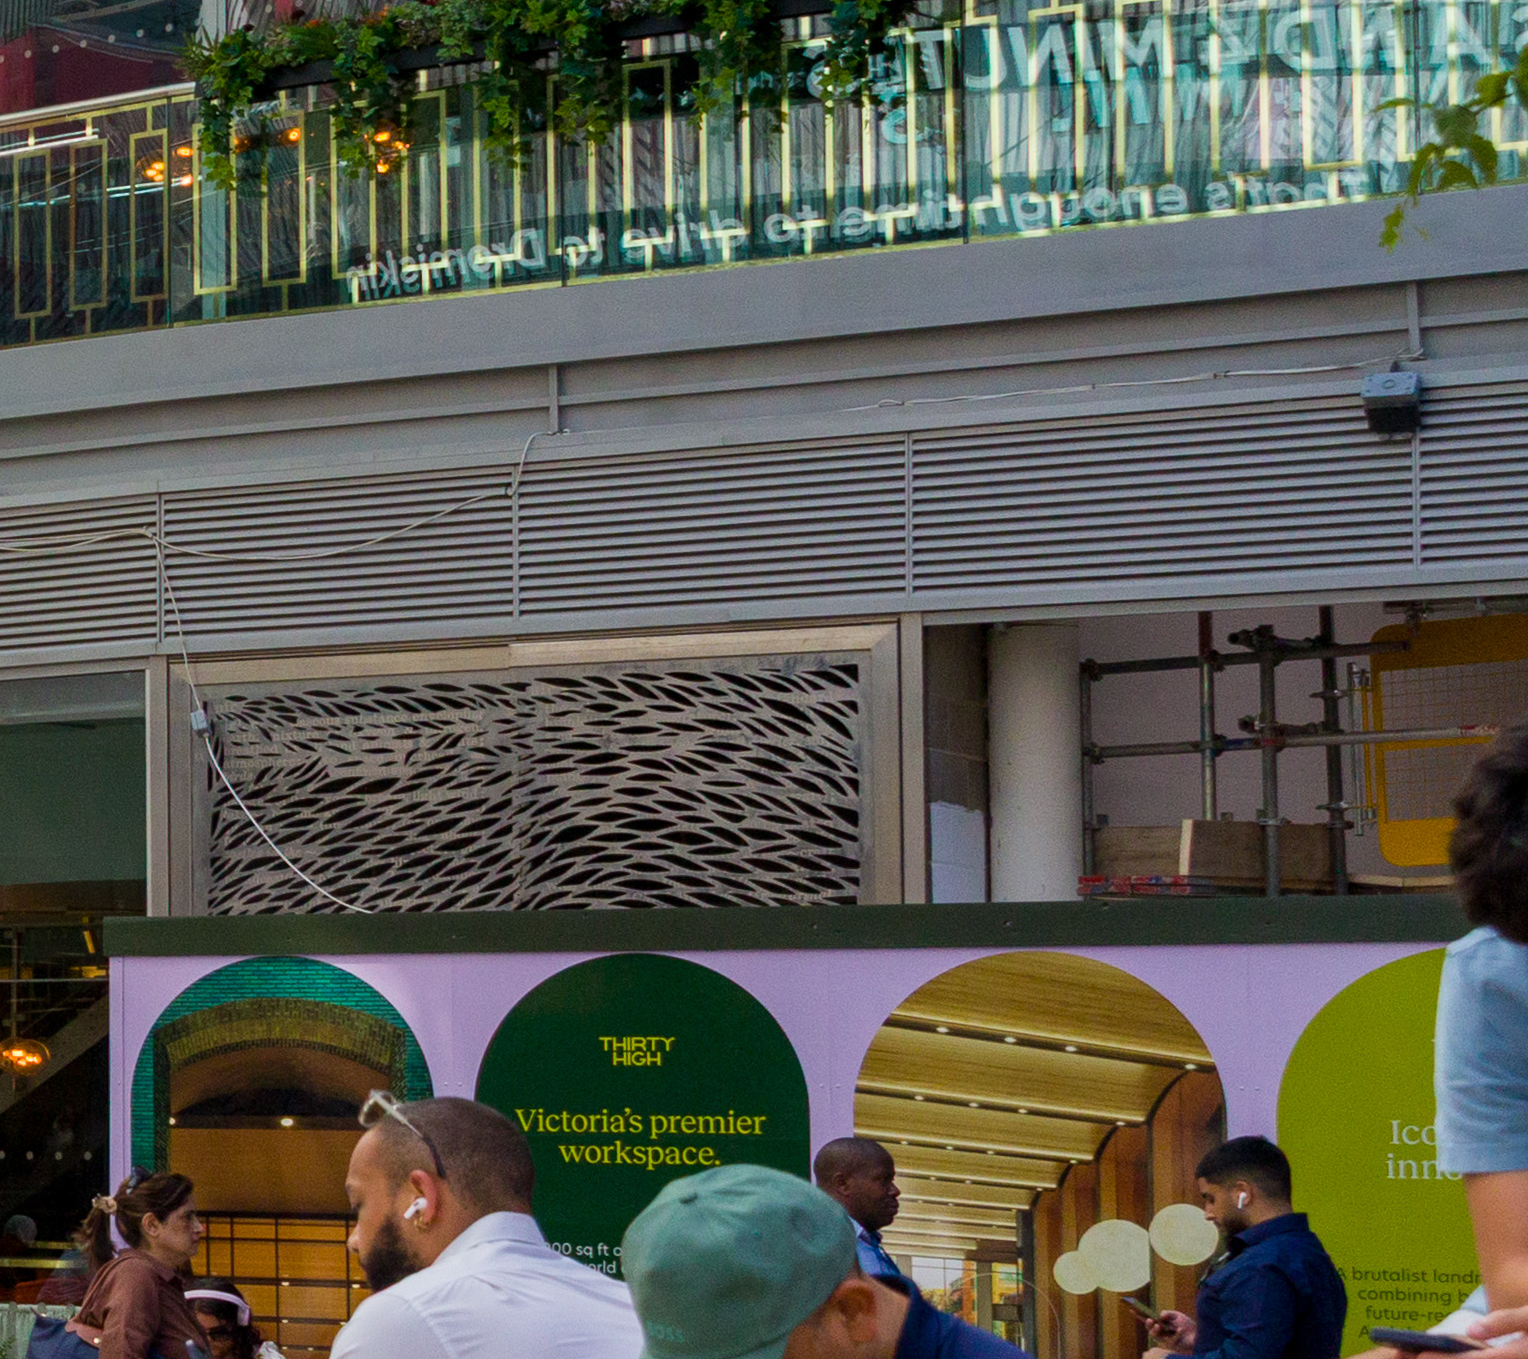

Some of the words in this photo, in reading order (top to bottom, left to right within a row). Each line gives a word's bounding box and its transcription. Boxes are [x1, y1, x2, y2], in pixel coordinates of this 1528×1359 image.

[599, 1037, 676, 1052] THIRTY
[612, 1052, 662, 1066] HIGH
[515, 1107, 643, 1133] Victoria's
[649, 1110, 767, 1139] premier
[558, 1140, 721, 1171] workspace.
[576, 1245, 593, 1259] sq
[597, 1242, 609, 1257] ft
[583, 1259, 617, 1274] orld
[1352, 1267, 1428, 1283] brutalist
[1357, 1288, 1452, 1306] combining
